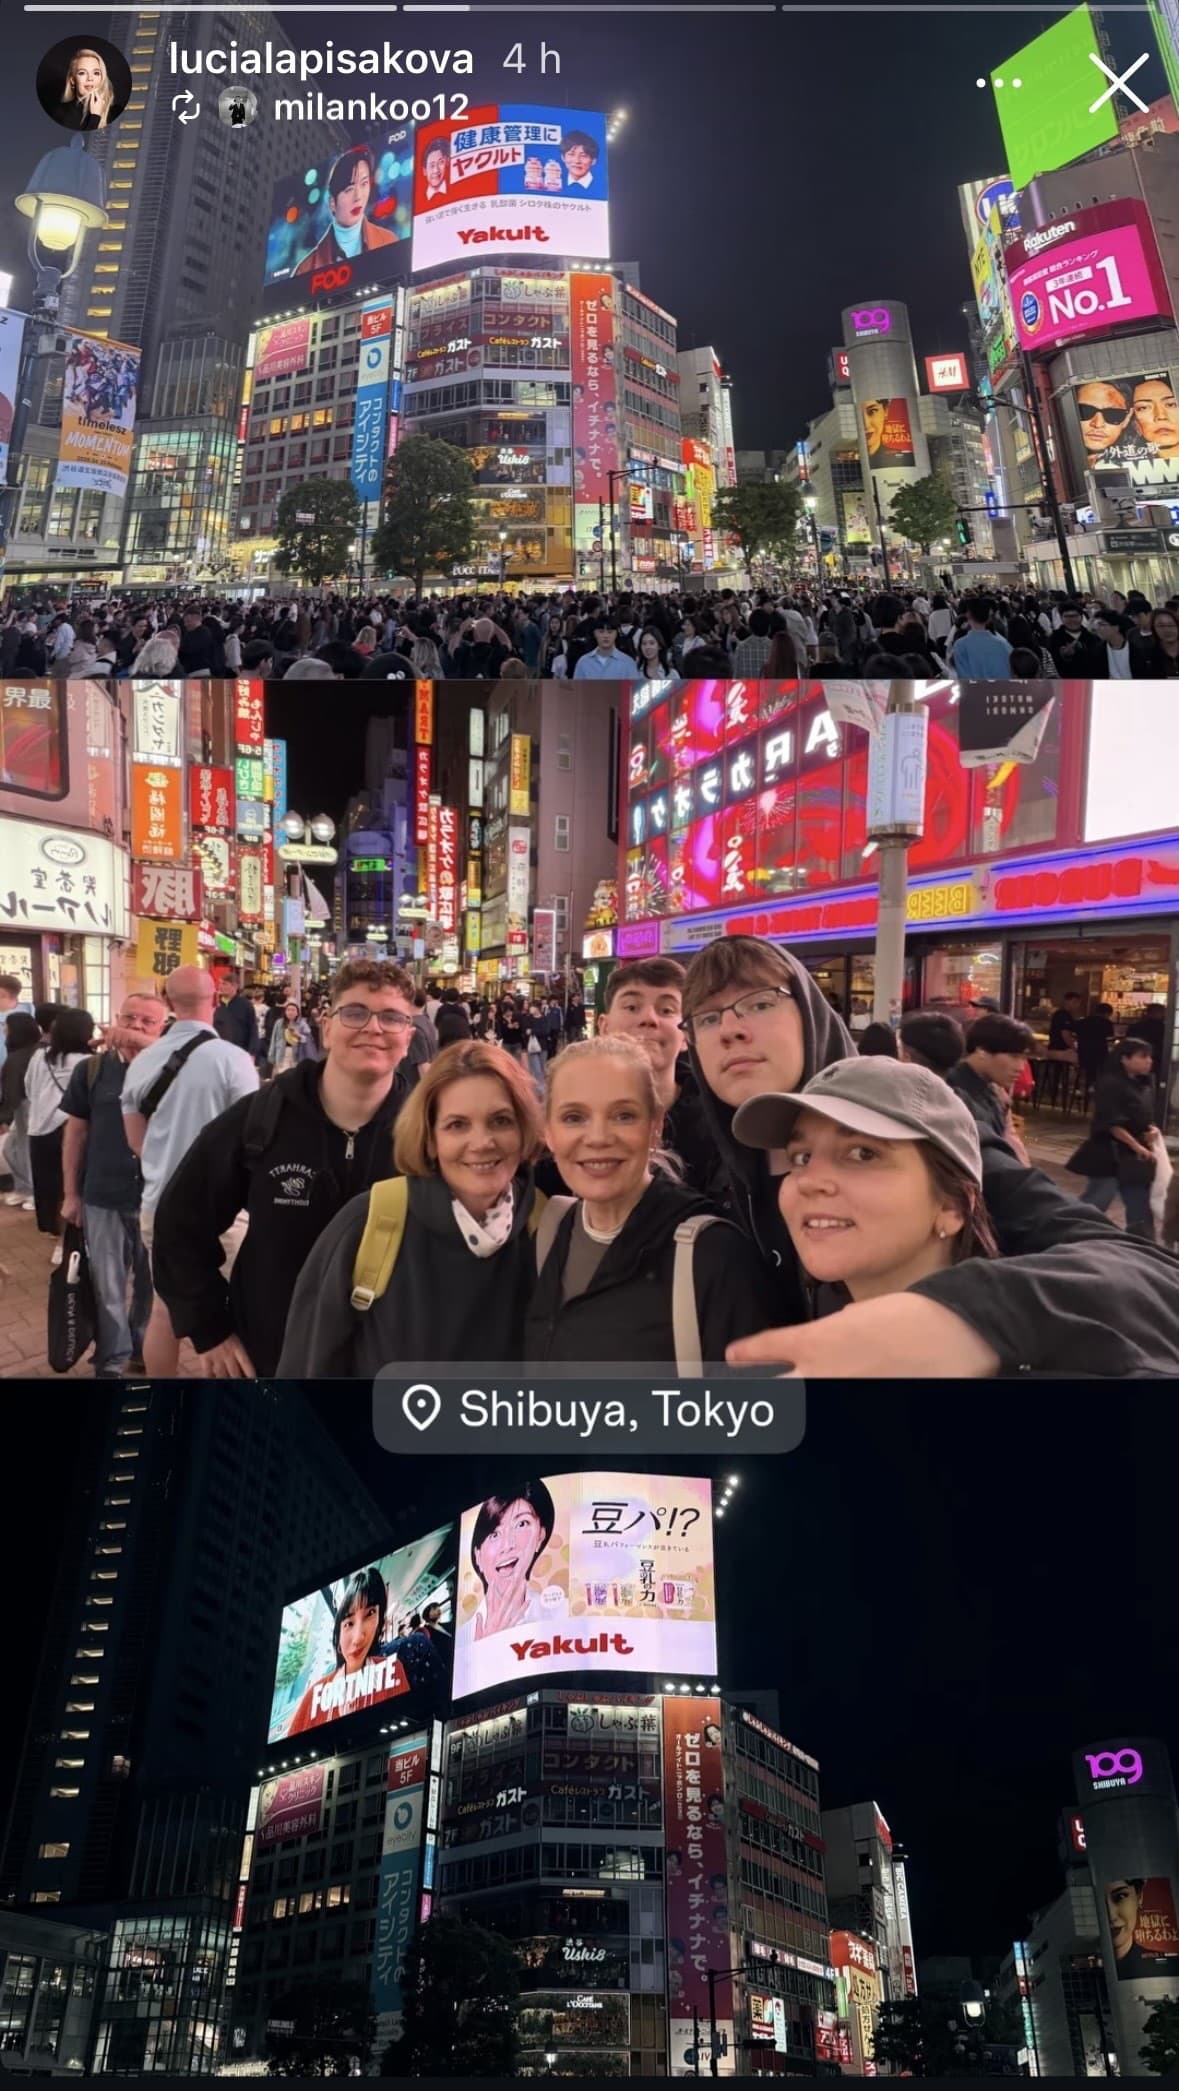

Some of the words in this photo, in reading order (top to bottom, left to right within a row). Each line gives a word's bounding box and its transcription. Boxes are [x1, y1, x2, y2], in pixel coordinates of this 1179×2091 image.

[453, 124, 559, 153] 健康管理に
[452, 147, 522, 177] ヤクルト
[457, 225, 550, 245] Yakult
[1023, 220, 1076, 251] Rakuten
[311, 265, 351, 294] FOD
[1048, 255, 1133, 325] No.1
[484, 313, 551, 327] コンタクト
[850, 308, 890, 334] 109
[447, 337, 473, 353] ガスト
[530, 336, 563, 349] ガスト
[581, 1500, 700, 1538] 豆パ!?
[510, 1633, 635, 1661] Yakult
[600, 1714, 657, 1732] しゃぶ葉
[394, 1753, 419, 1772] 当ビル
[544, 1754, 636, 1772] コンタクト
[1085, 1748, 1143, 1784] 109
[400, 1769, 413, 1785] 5F
[496, 1786, 527, 1808] ガスト
[608, 1784, 650, 1800] ガスト
[684, 1732, 709, 1983] ゼロを見るなら、イチナナで。
[378, 1873, 399, 1985] アイシティ
